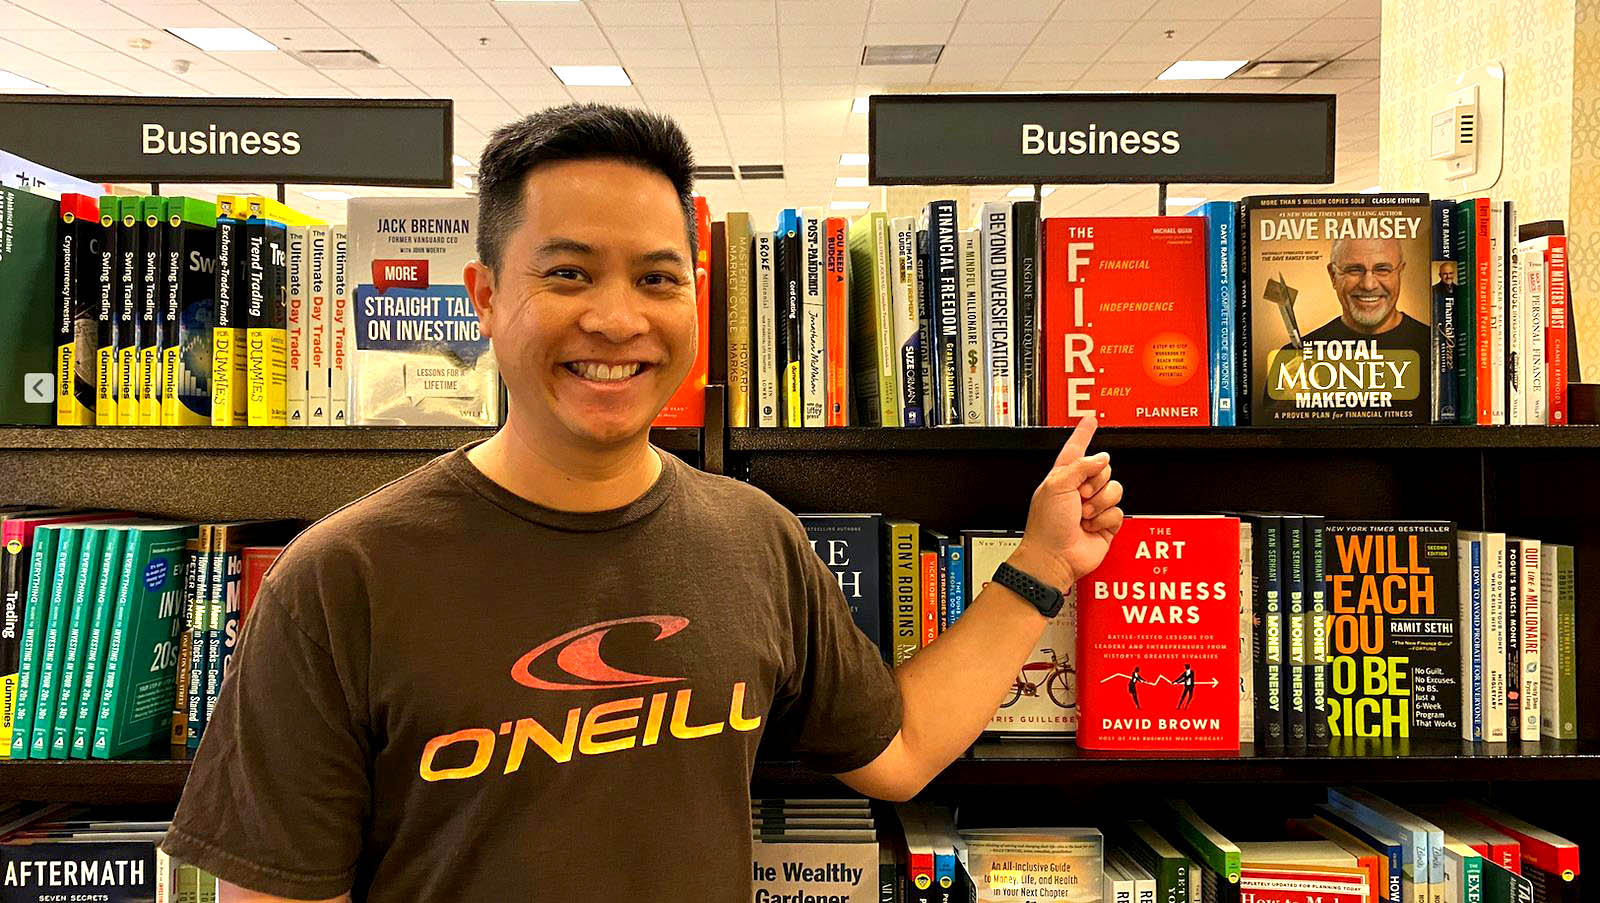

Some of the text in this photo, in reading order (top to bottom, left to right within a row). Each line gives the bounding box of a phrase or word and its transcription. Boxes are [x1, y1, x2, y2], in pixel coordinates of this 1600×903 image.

[141, 123, 301, 155] Business
[1022, 123, 1181, 155] Business
[377, 219, 470, 234] JACK BRENNAN
[836, 228, 844, 247] YOU
[1069, 227, 1094, 239] THE
[1260, 217, 1421, 241] DAVE RAMSEY
[1442, 209, 1450, 259] DAVE RAMSEY
[291, 241, 301, 295] Ultimate
[313, 238, 323, 292] Ultimate
[807, 219, 818, 296] POST-PANDEMIC
[827, 237, 835, 273] BUDGET
[938, 205, 957, 336] FINANCIAL FREEDOM
[966, 251, 976, 288] MINDFUL
[1099, 260, 1150, 269] FINANCIAL
[61, 235, 72, 333] Cryptocurrency Investing
[99, 252, 111, 321] Swing Trading
[121, 252, 133, 321] Swing Trading
[144, 252, 156, 321] Swing Trading
[167, 252, 179, 321] Swing Trading
[219, 224, 231, 325] Exchange-Traded Funds
[249, 236, 263, 316] Trend Trading
[385, 266, 418, 281] MORE
[1551, 247, 1565, 329] WHAT MATTERS MOST
[312, 296, 323, 321] Day
[365, 297, 477, 317] STRAIGHT TAL
[990, 213, 1008, 377] BEYOND DIVERSIFICATION
[1099, 302, 1174, 312] INDEPENDENCE
[290, 299, 300, 324] Day
[967, 291, 977, 345] MILLIONAIRE
[313, 325, 323, 368] Trader
[368, 320, 480, 341] ON INVESTING
[1531, 295, 1542, 391] PERSONAL FINANCE
[290, 328, 300, 370] Trader
[1100, 345, 1134, 354] RETIRE
[1303, 341, 1313, 361] THE
[1313, 339, 1383, 361] TOTAL
[61, 347, 71, 396] dummies
[100, 350, 110, 399] dummies
[122, 350, 132, 399] dummies
[143, 350, 153, 399] dummies
[166, 350, 176, 399] dummies
[424, 381, 457, 390] LIFETIME
[1275, 360, 1411, 391] MONEY
[1100, 388, 1131, 396] EARLY
[1295, 392, 1392, 409] MAKEOVER
[1136, 406, 1198, 417] PLANNER
[1384, 410, 1413, 418] FITNESS
[1135, 541, 1186, 559] ART
[1335, 535, 1430, 574] WILL
[1525, 548, 1538, 569] QUIT
[1509, 549, 1517, 584] POGUE'S
[1527, 571, 1535, 586] LIKE
[897, 534, 914, 637] TONY ROBBINS
[1094, 581, 1226, 600] BUSINESS
[1325, 575, 1435, 615] EACH
[1473, 588, 1481, 599] TO
[3, 591, 18, 638] Trading
[186, 593, 194, 628] LYNCH
[1122, 605, 1200, 624] WARS
[1473, 601, 1481, 626] AVOID
[1525, 594, 1538, 654] MILLIONAIRE
[1390, 622, 1453, 634] RAMIT SETHI
[1267, 591, 1279, 712] BIG MONEY ENERGY
[1291, 591, 1303, 712] BIG MONEY ENERGY
[1313, 591, 1325, 712] BIG MONEY ENERGY
[1473, 627, 1481, 664] PROBATE
[1327, 656, 1410, 696] O BE
[1426, 676, 1456, 684] Excuses.
[3, 678, 13, 728] dummies
[1415, 702, 1442, 710] 6-Week
[1416, 711, 1445, 720] Program
[419, 681, 761, 782] O'NEILL
[1102, 719, 1220, 730] DAVID BROWN
[1433, 720, 1456, 728] Works
[4, 859, 144, 887] AFTERMATH
[753, 861, 863, 885] he Wealthy
[991, 862, 1071, 872] An All-Inclusive Guide
[994, 887, 1068, 899] in Your Next Chapter
[1390, 876, 1400, 902] HOW
